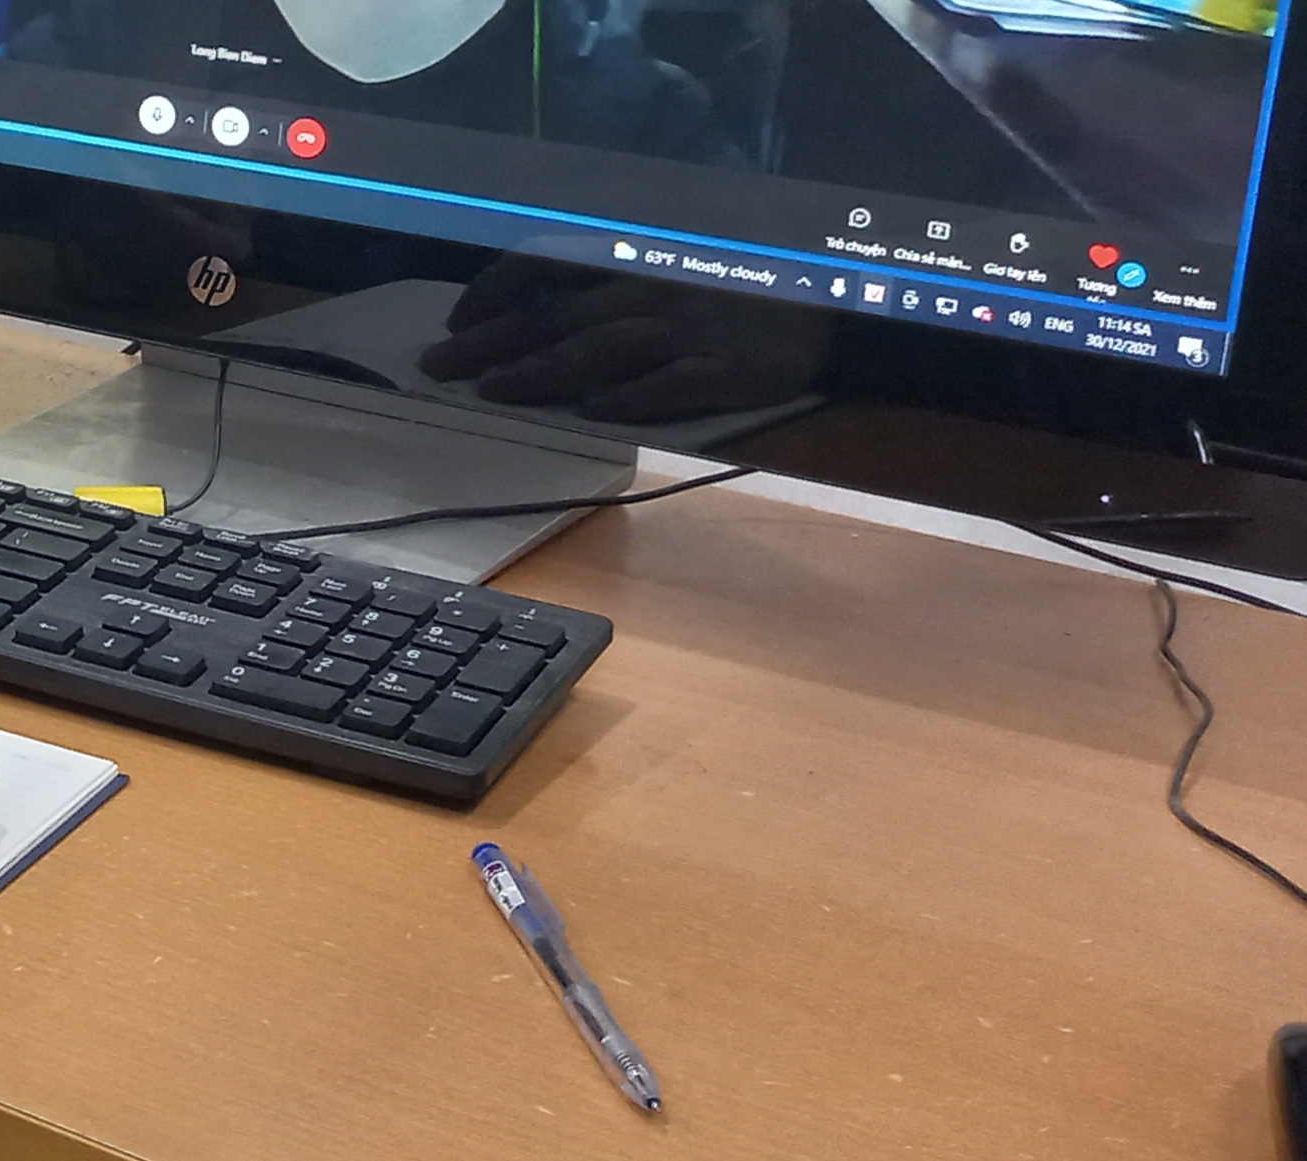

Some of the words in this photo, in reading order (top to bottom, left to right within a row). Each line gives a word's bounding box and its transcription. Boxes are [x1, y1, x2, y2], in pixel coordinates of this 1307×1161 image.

[644, 249, 677, 267] 63°F
[682, 255, 730, 279] Mostly
[730, 264, 778, 287] cloudy
[1007, 266, 1026, 282] tay
[193, 255, 233, 307] hp
[1152, 289, 1182, 307] Xem
[1183, 295, 1218, 312] thêm
[1043, 316, 1075, 334] ENG
[1097, 315, 1131, 333] 11:14
[1132, 321, 1153, 337] SA
[1085, 332, 1158, 358] 30/12/2021
[303, 597, 317, 608] 7
[365, 611, 380, 622] 8
[279, 619, 294, 630] 4
[428, 626, 444, 637] 9
[341, 633, 357, 645] 5
[256, 642, 267, 652] 1
[406, 648, 421, 660] 6
[321, 657, 334, 668] 2
[231, 665, 246, 677] 0
[385, 672, 399, 683] 3
